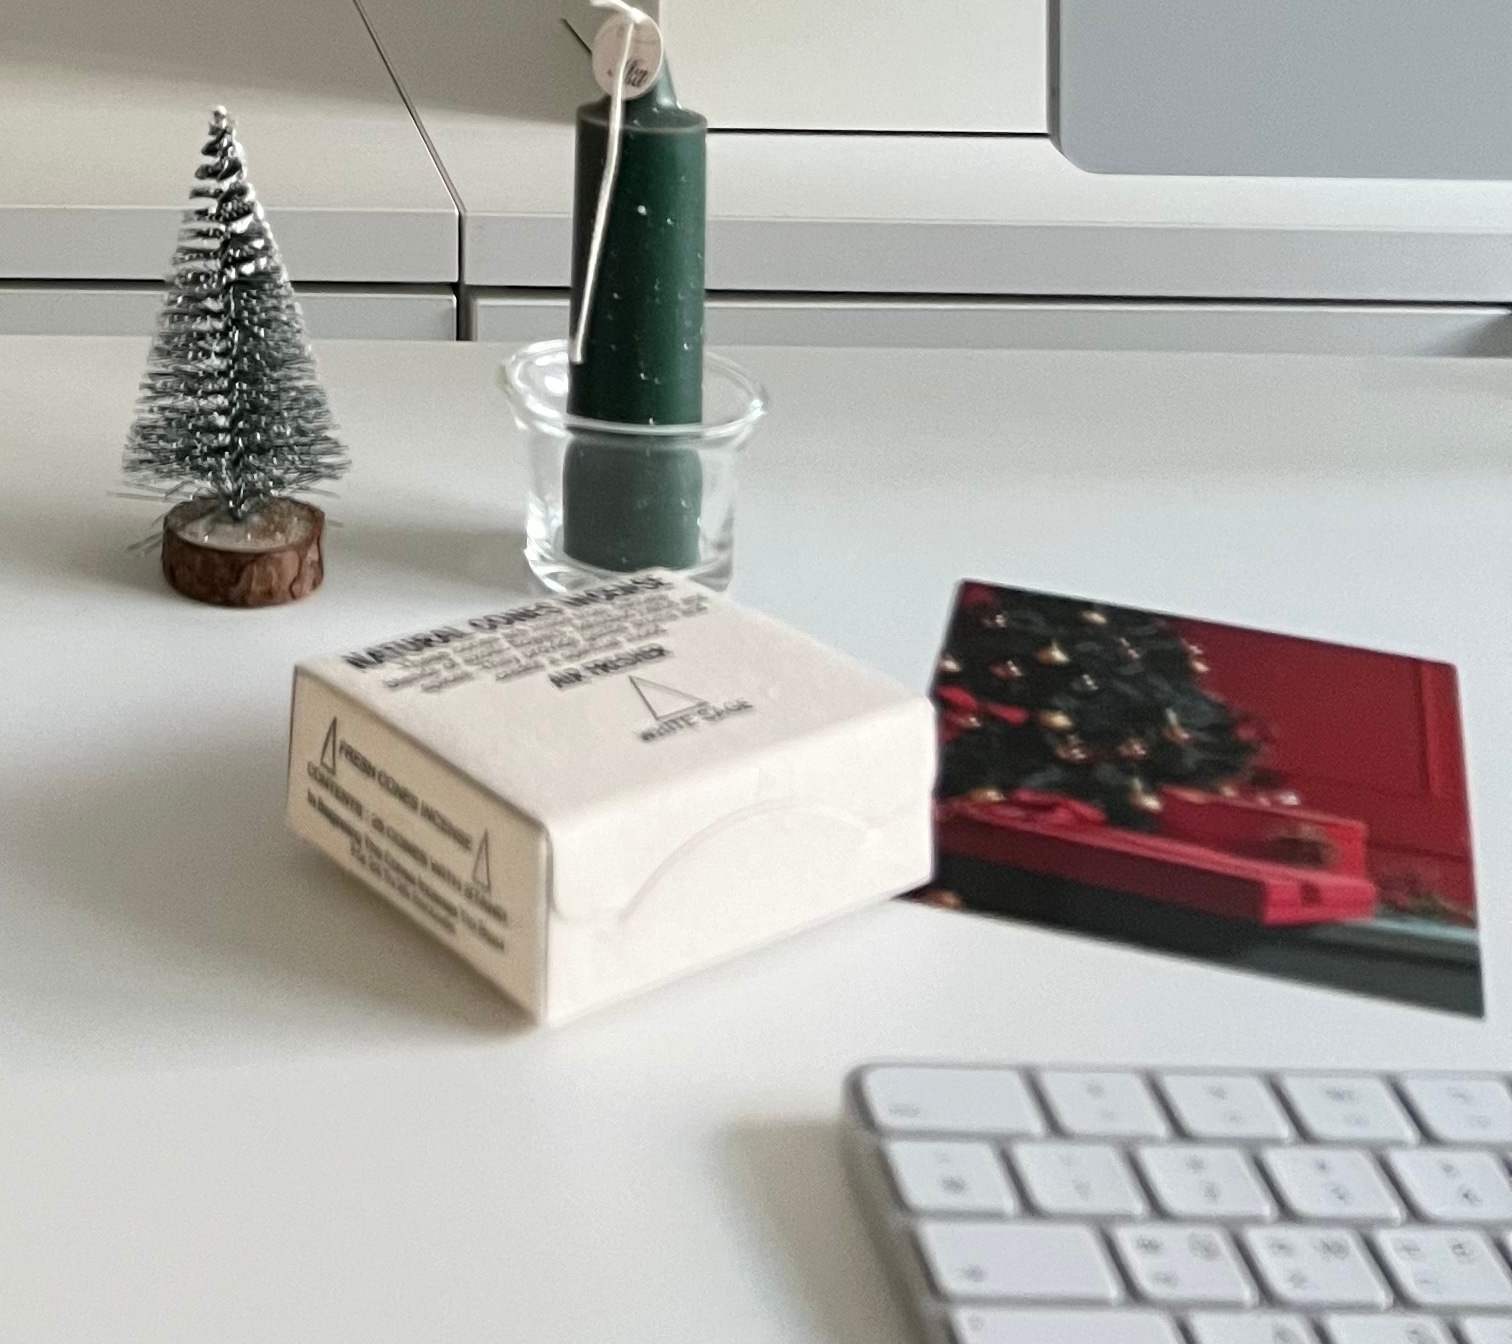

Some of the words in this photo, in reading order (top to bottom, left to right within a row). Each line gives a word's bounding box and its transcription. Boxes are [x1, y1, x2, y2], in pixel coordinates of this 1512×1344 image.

[342, 624, 473, 671] NATURAL
[468, 598, 566, 631] CONES
[564, 574, 674, 609] INCENSE
[548, 667, 586, 690] AIR
[639, 713, 698, 743] WHITE
[696, 697, 755, 722] SAGE
[339, 738, 377, 780] FRESH
[376, 769, 420, 811] CONES
[419, 799, 473, 852] INCENSE
